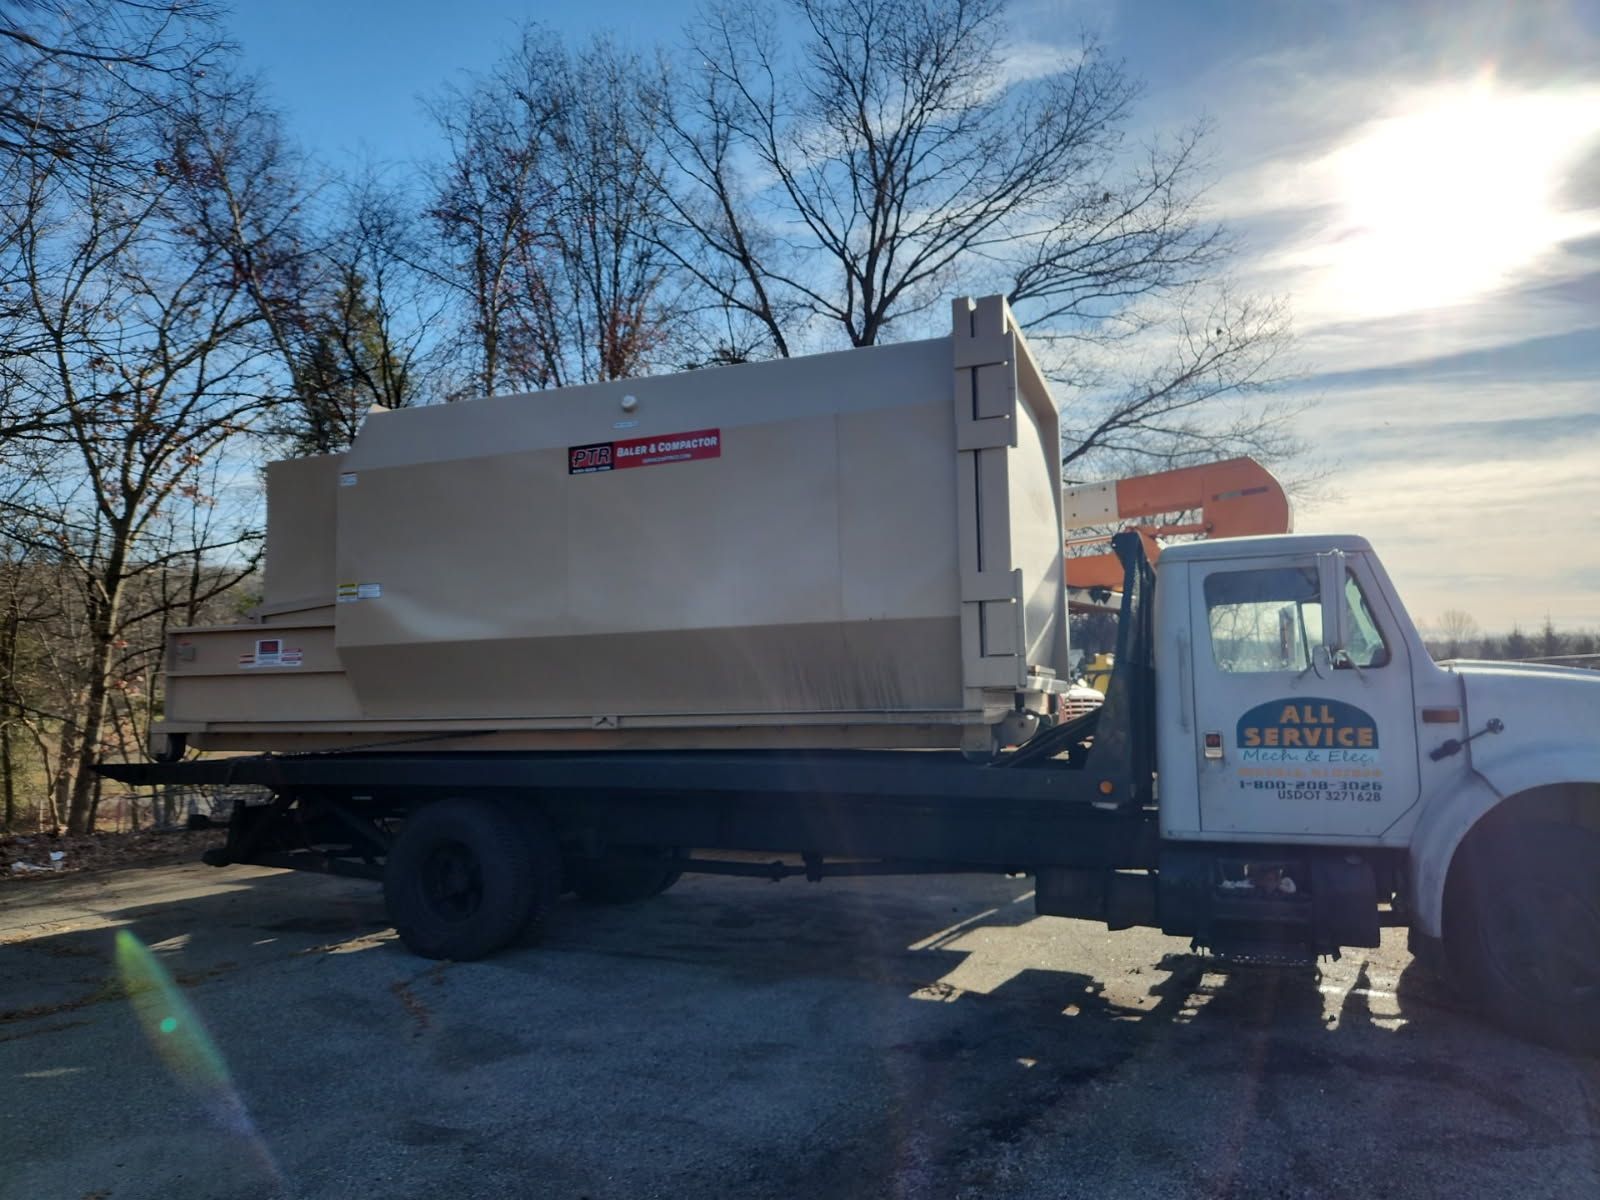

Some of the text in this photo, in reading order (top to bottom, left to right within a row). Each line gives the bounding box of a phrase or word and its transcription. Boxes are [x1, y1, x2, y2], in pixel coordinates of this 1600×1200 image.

[616, 436, 718, 457] BALER & COMPACTOR
[572, 447, 611, 467] PTR
[1279, 705, 1335, 723] ALL
[1244, 727, 1373, 747] SERVICE
[1243, 750, 1299, 762] Mech.
[1305, 751, 1320, 762] &
[1277, 790, 1382, 802] USDOT 3271628
